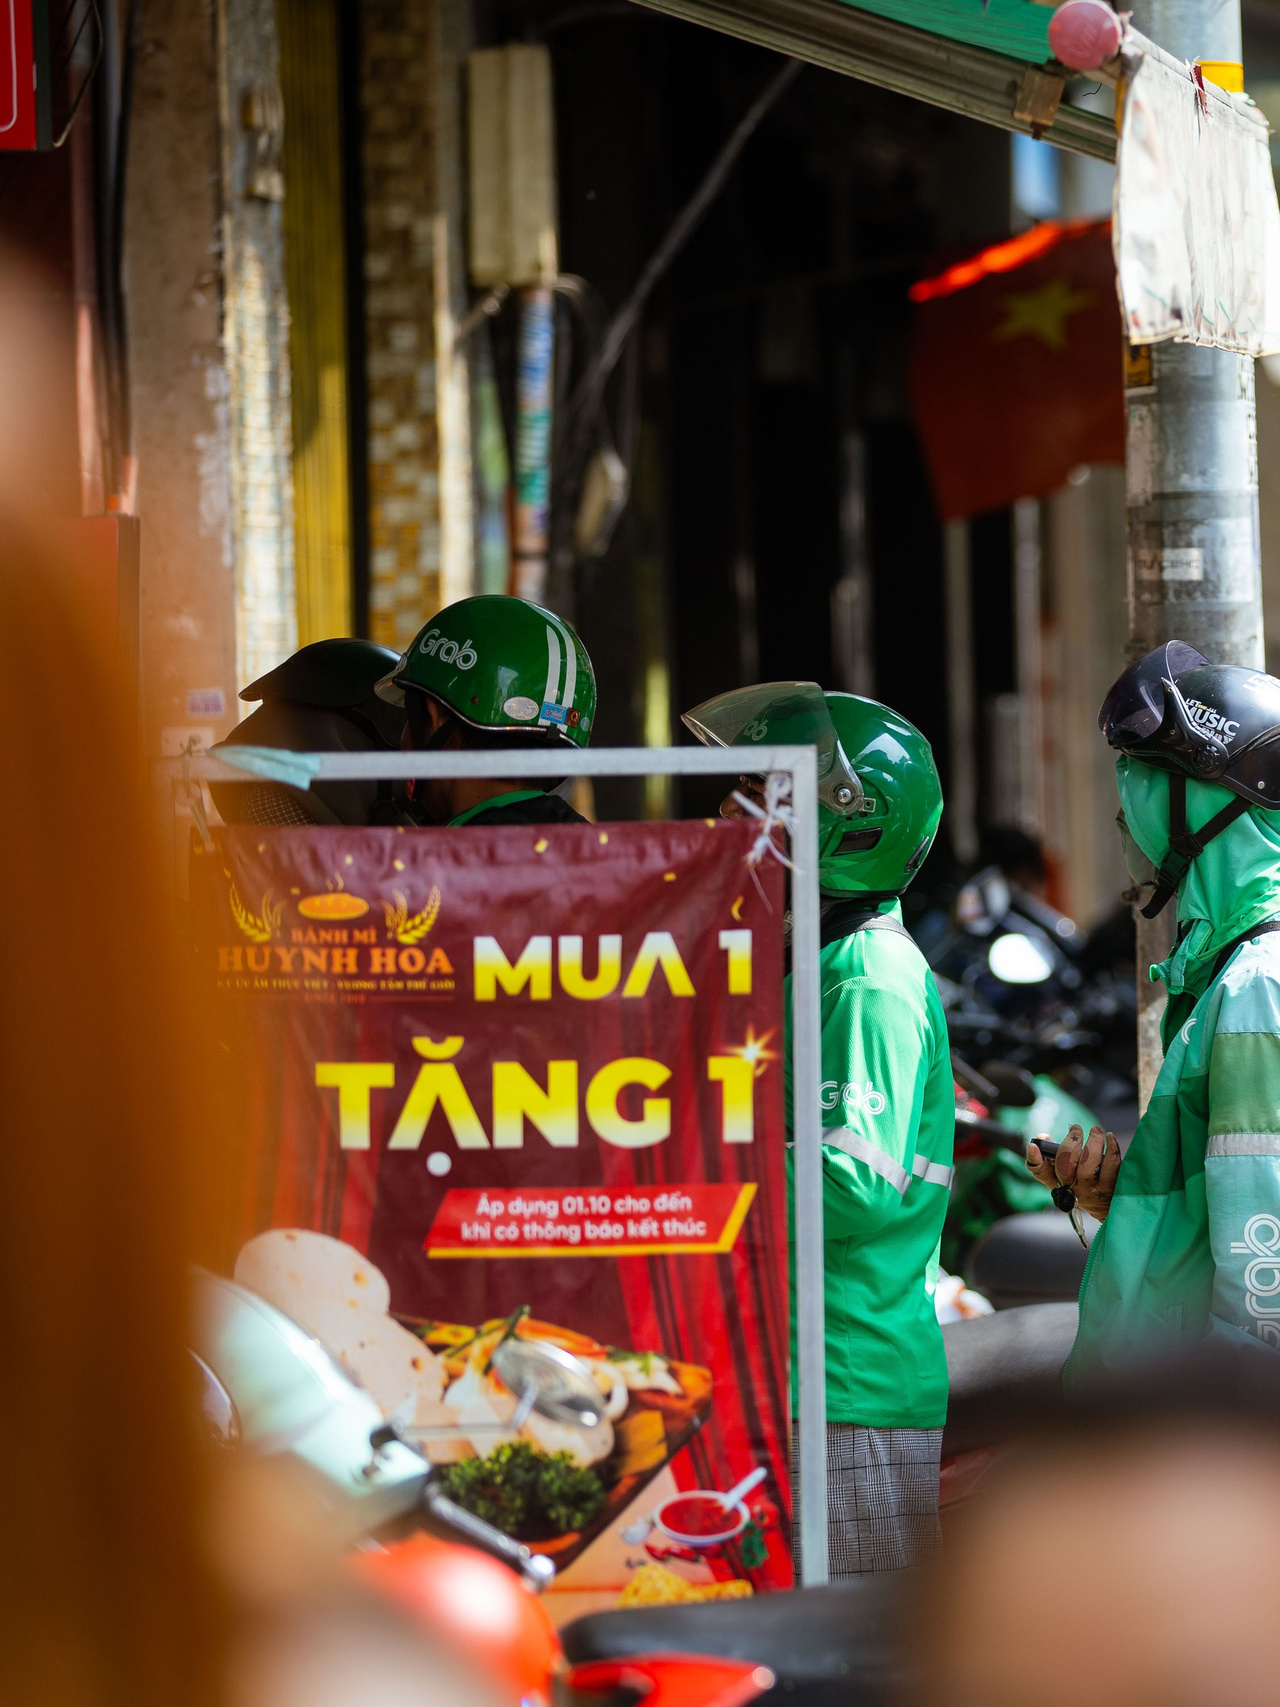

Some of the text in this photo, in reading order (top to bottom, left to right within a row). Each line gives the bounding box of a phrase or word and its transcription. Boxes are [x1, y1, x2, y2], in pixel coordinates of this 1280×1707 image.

[419, 628, 478, 671] Grab
[369, 946, 455, 975] HOA
[473, 929, 753, 1001] MUA 1
[315, 1036, 754, 1177] TẶNG 1
[476, 1191, 692, 1219] Áp dụng 01.10 cho đến
[461, 1216, 707, 1244] khi có thông báo kết thúc
